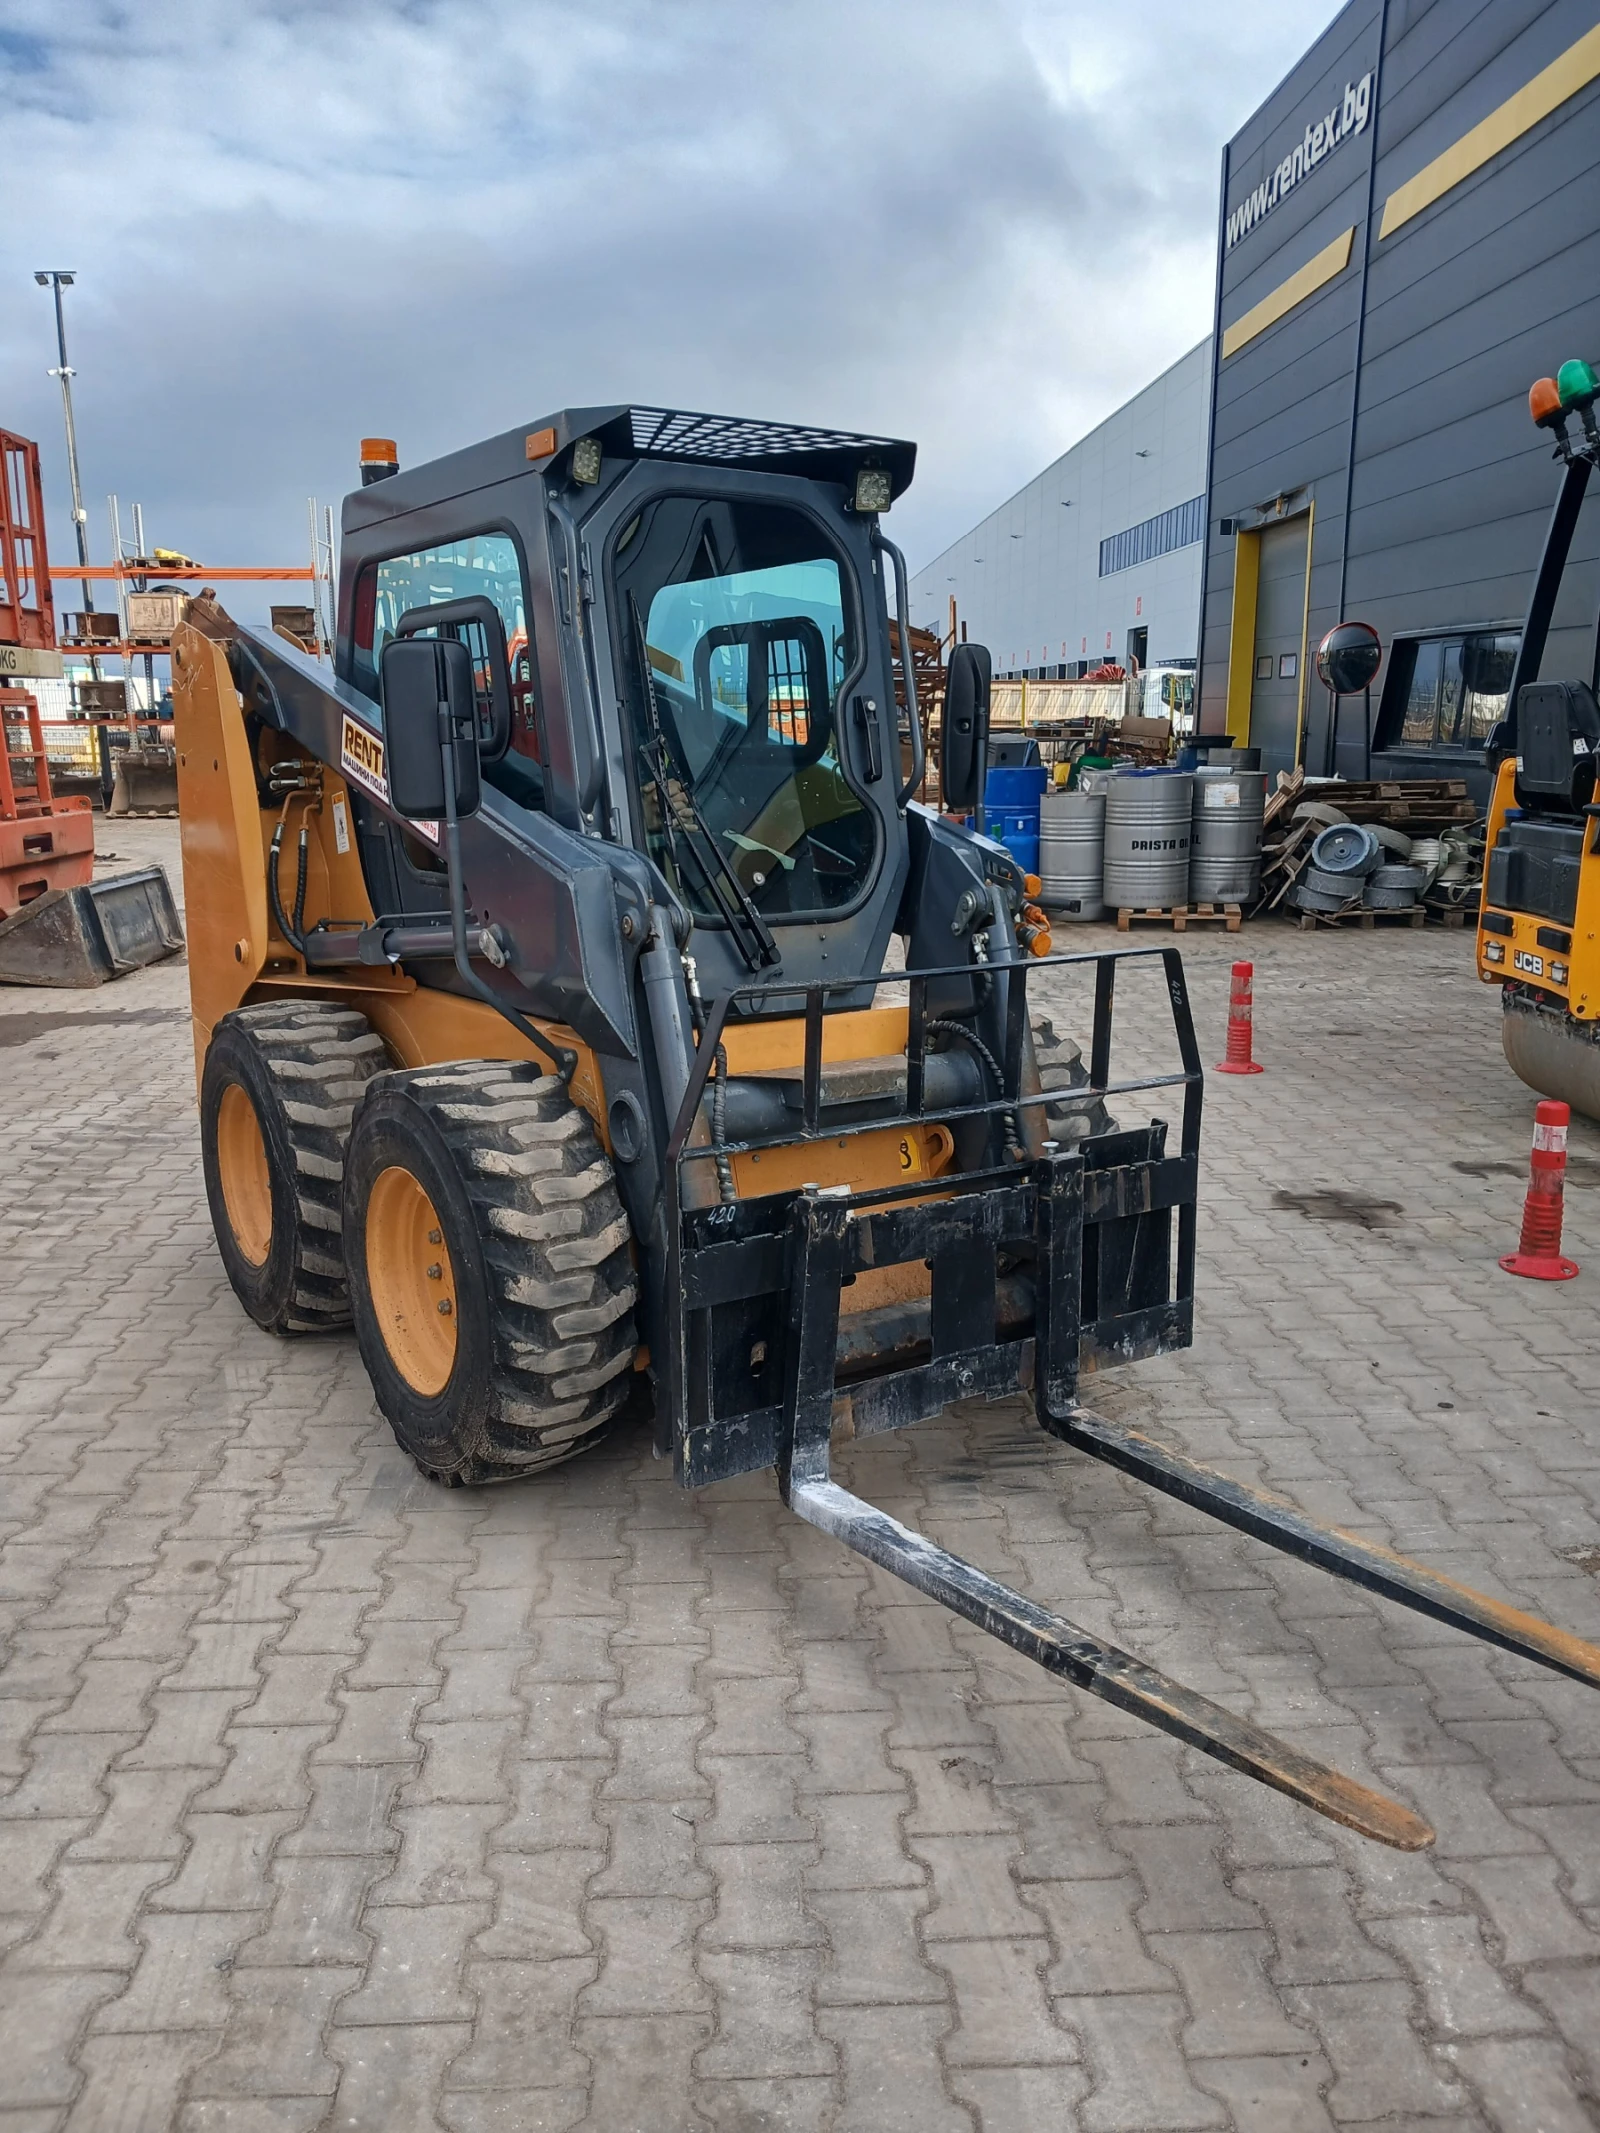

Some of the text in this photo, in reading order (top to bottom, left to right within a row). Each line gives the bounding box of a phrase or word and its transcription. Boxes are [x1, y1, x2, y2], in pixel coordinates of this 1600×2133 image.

[1227, 73, 1371, 248] www.rentex.bg
[0, 649, 16, 670] KG
[345, 722, 384, 774] RENT
[343, 752, 371, 783] МАШИНИ
[1132, 840, 1176, 850] PRISTA
[1514, 951, 1543, 976] JCB
[1171, 980, 1182, 1005] 420
[707, 1205, 736, 1225] 420
